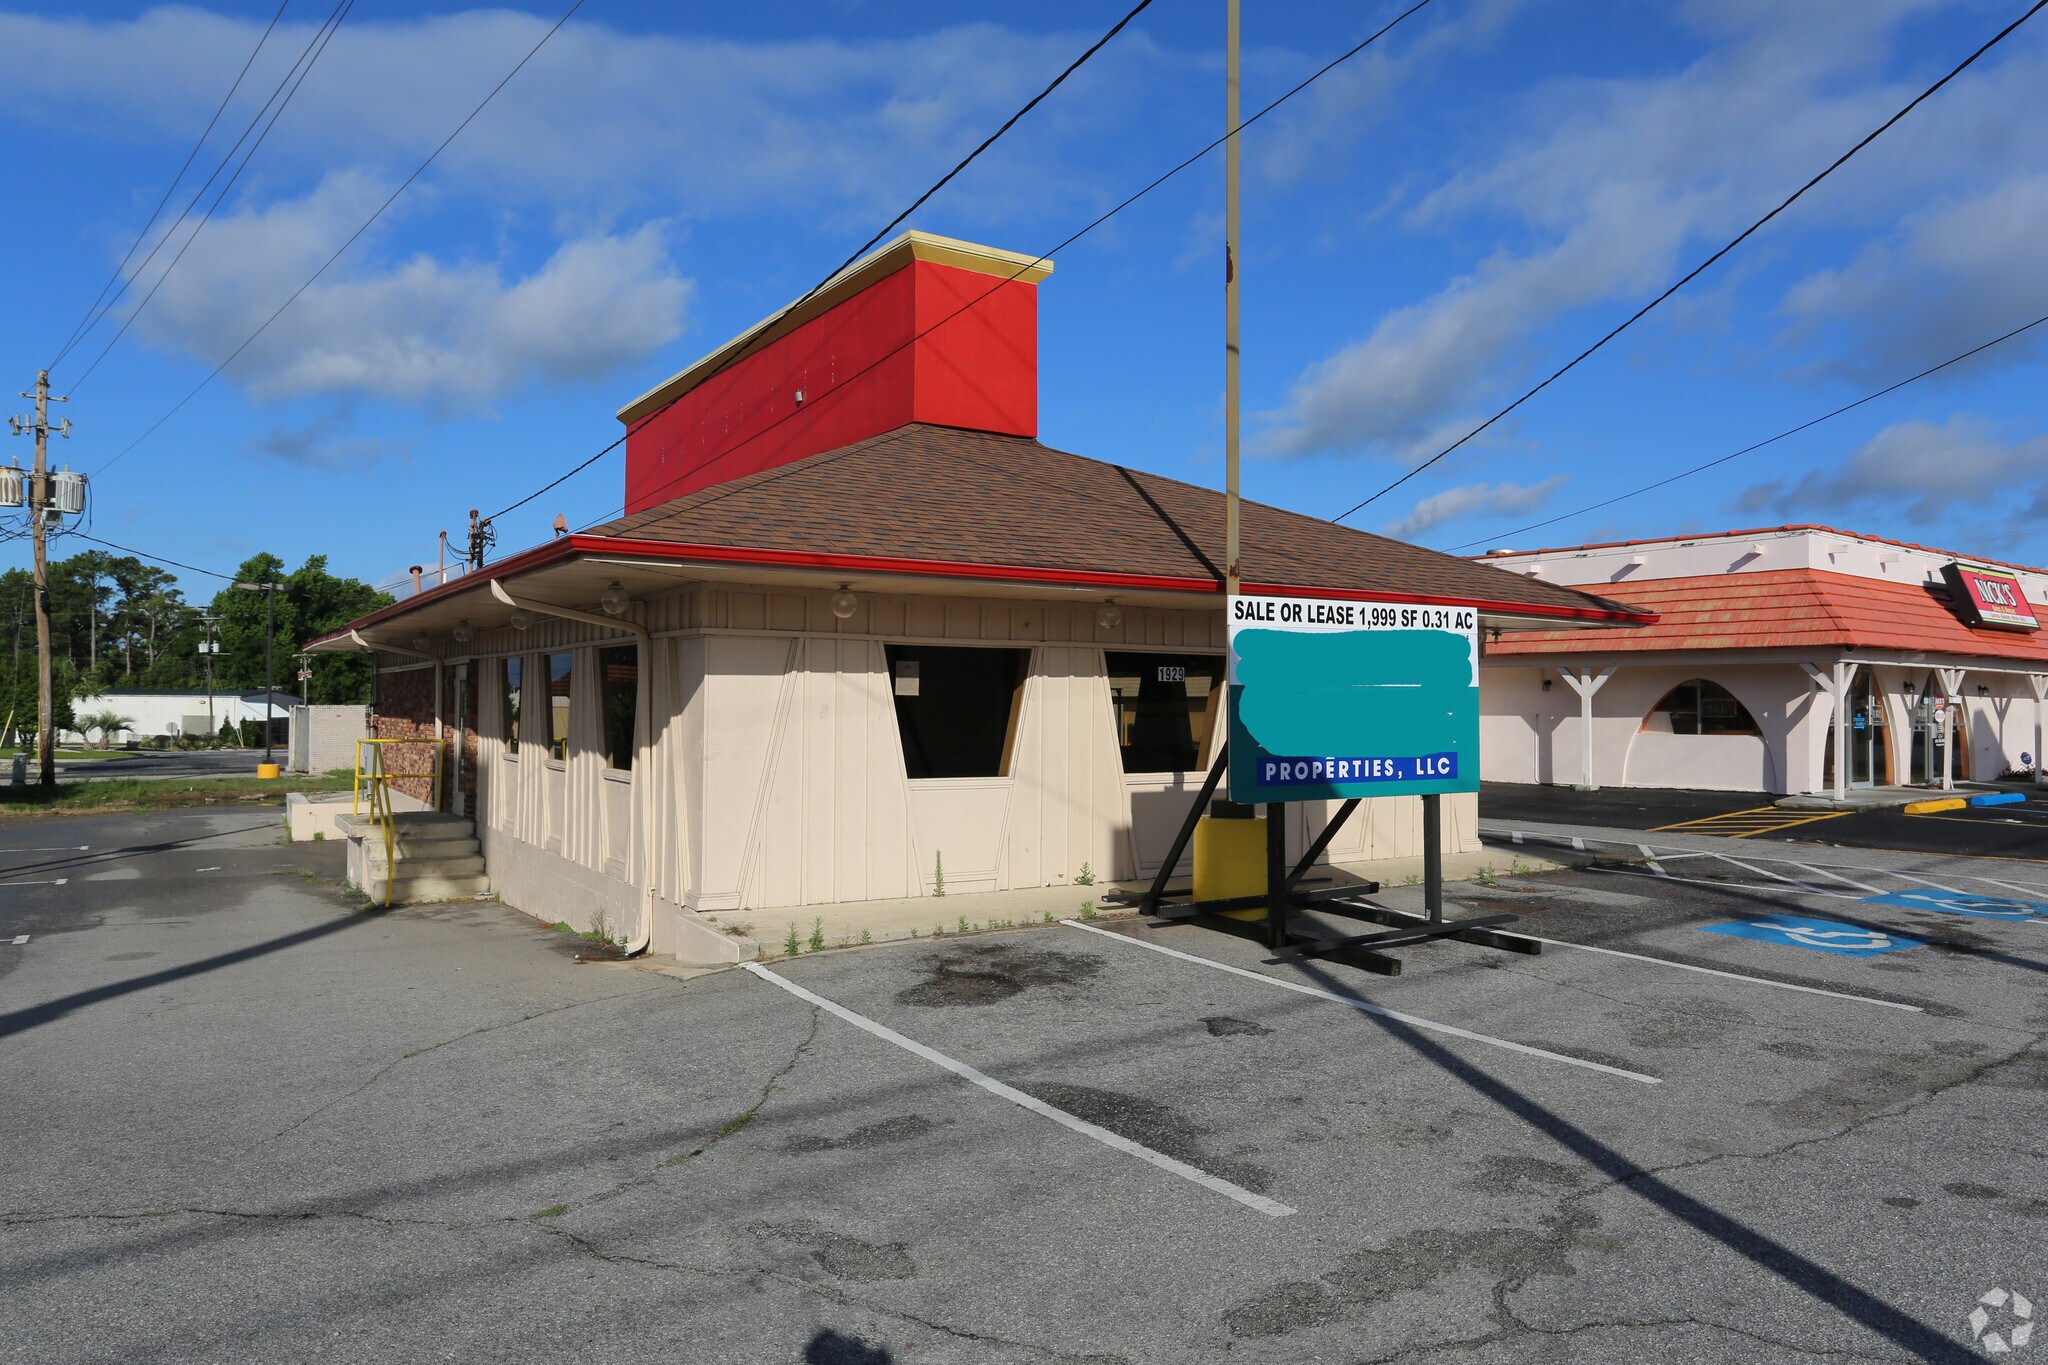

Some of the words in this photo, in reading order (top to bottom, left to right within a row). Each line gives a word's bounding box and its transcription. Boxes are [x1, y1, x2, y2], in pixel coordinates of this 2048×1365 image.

[1973, 577, 2017, 607] NICK'S
[1234, 600, 1275, 621] SALE
[1280, 603, 1302, 623] OR
[1307, 604, 1354, 625] LEASE
[1359, 607, 1397, 630] 1,999
[1401, 609, 1418, 628] SF
[1422, 610, 1449, 628] 0.31
[1455, 612, 1473, 629] AC
[1159, 667, 1184, 681] 1929
[1265, 758, 1403, 781] PROPERTIES,
[1416, 757, 1451, 776] LLC
